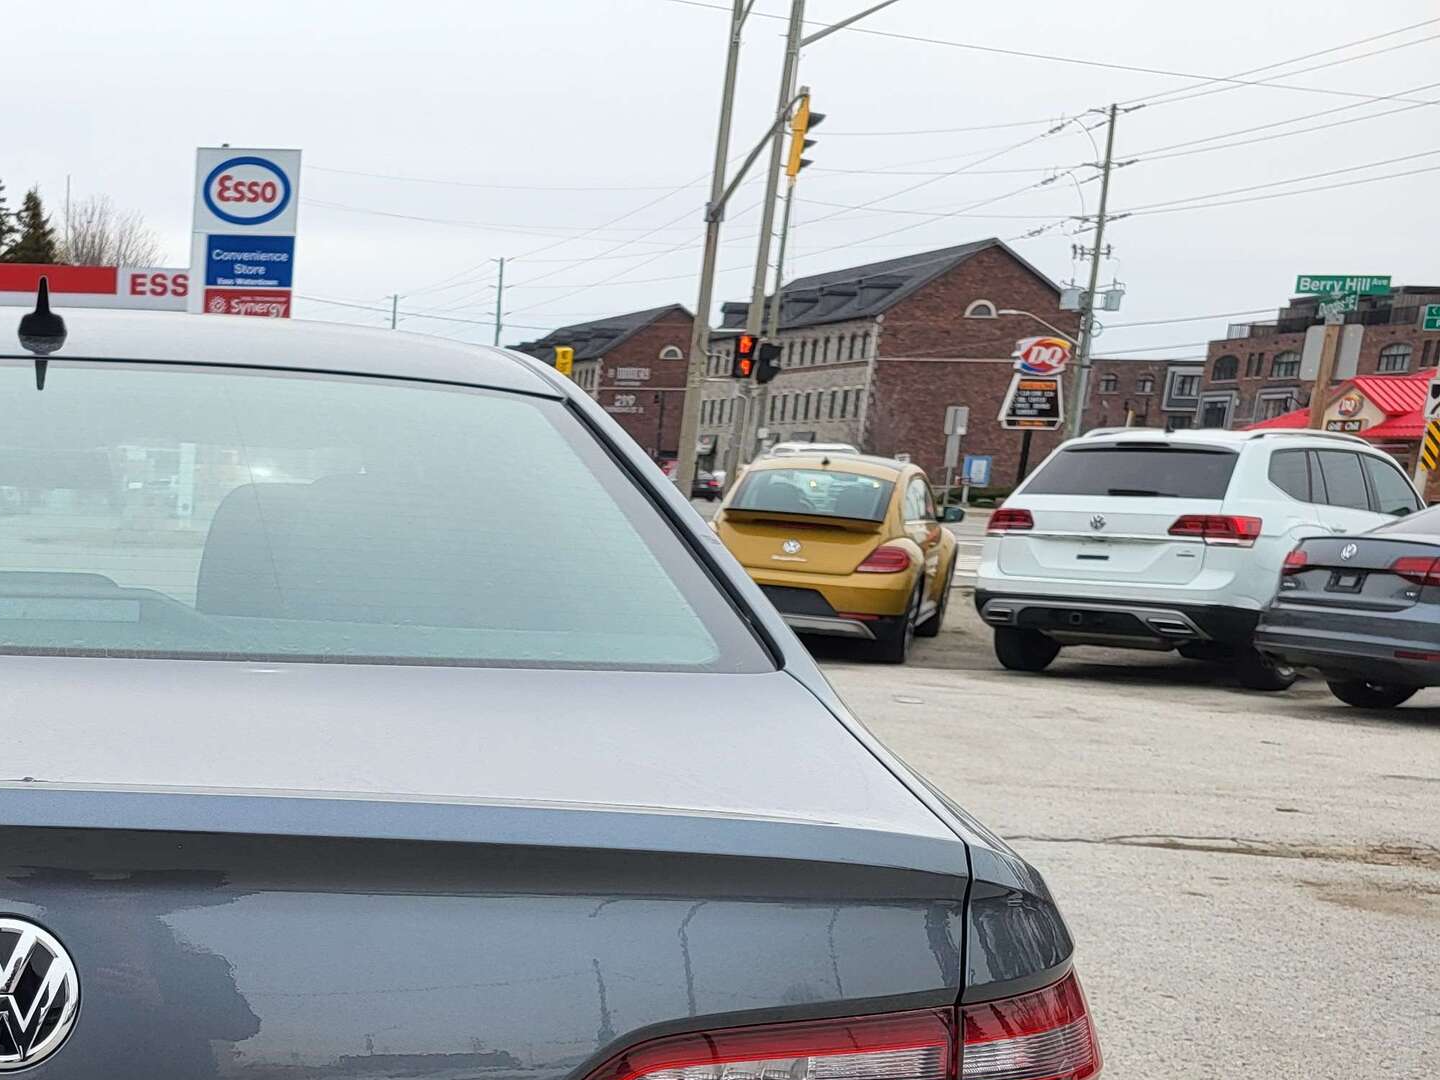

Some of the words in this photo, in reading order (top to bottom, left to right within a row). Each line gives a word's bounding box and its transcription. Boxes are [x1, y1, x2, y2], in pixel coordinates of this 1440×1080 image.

[212, 249, 289, 262] Convenience
[130, 273, 189, 297] ESS
[1299, 277, 1342, 292] Berry
[1345, 278, 1370, 291] Hill
[1028, 346, 1063, 367] DQ
